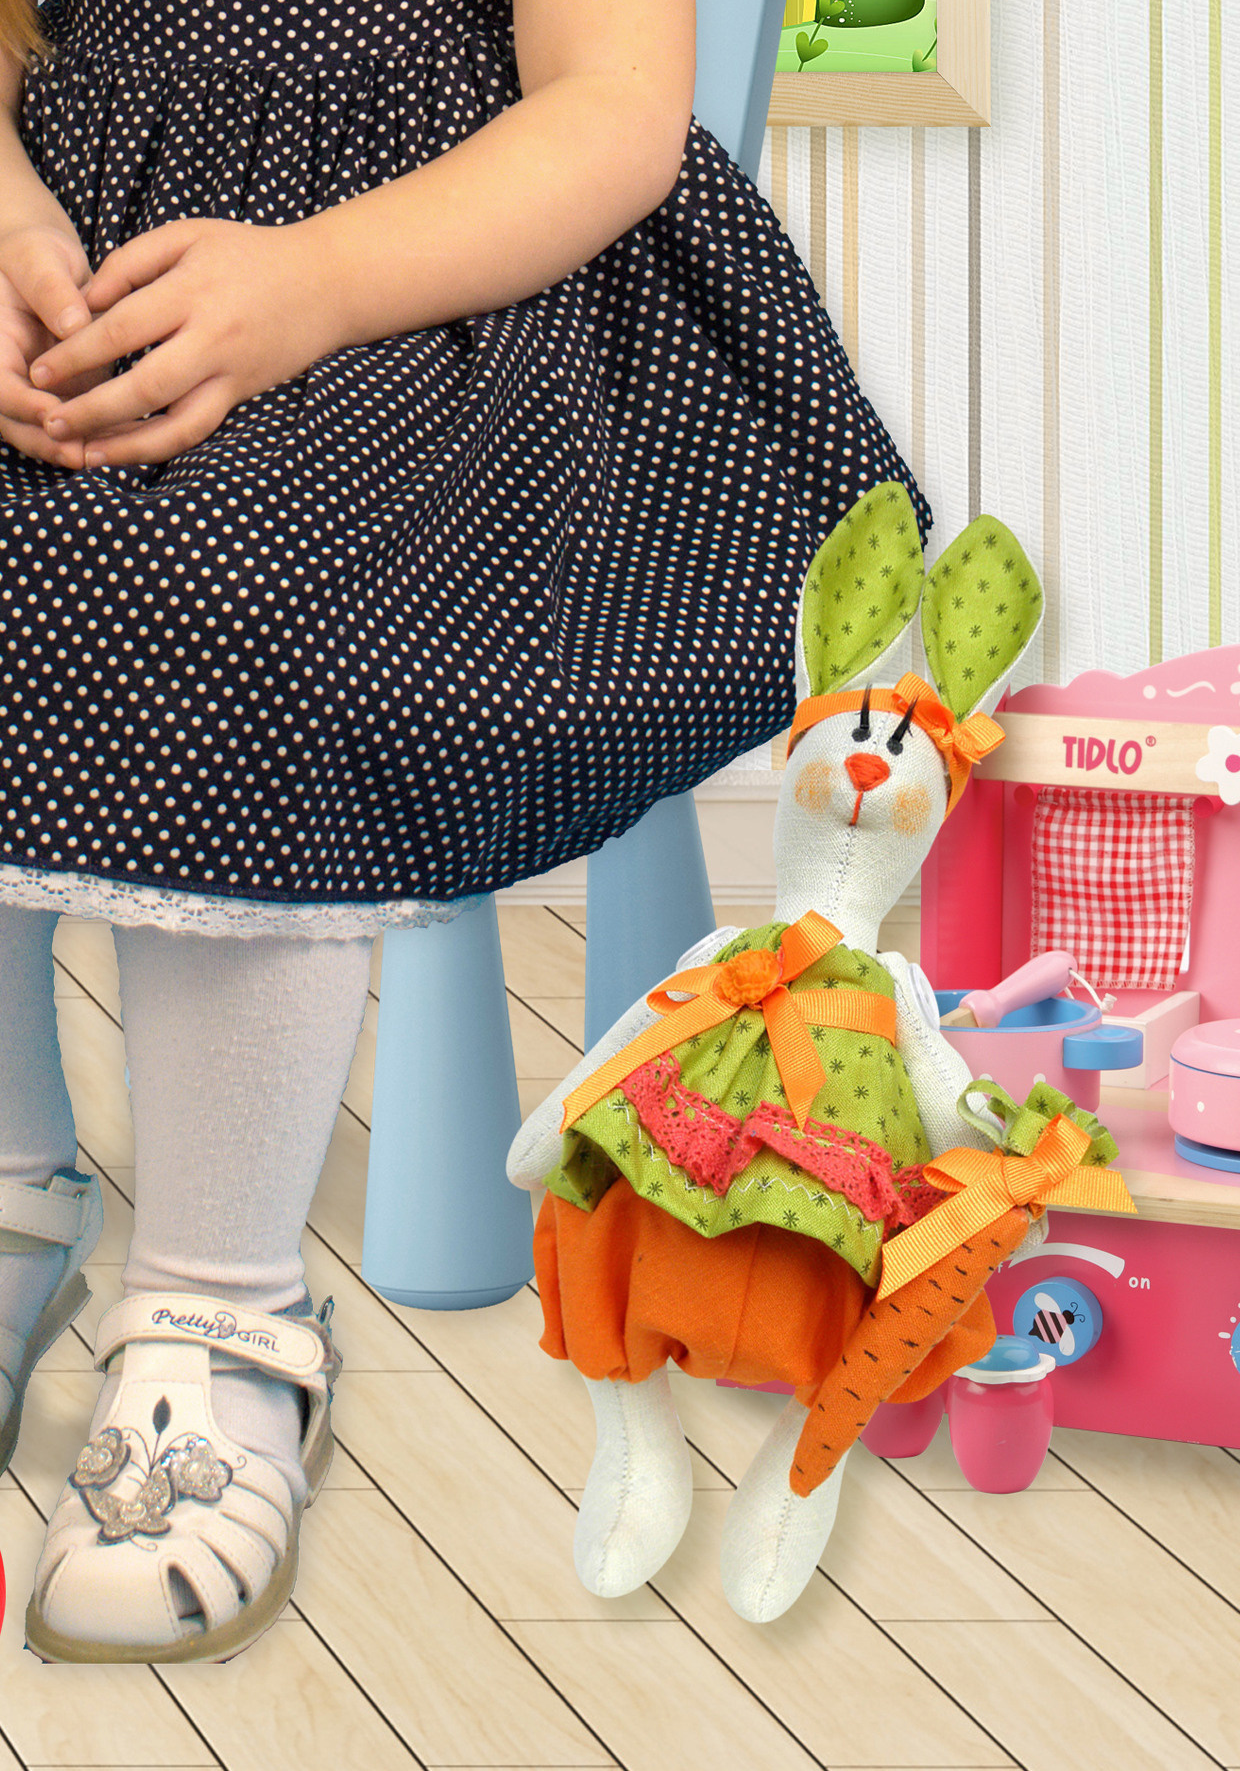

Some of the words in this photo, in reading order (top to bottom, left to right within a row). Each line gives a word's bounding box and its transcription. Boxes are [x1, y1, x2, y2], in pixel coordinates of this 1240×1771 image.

[1128, 1276, 1151, 1290] on
[151, 1308, 220, 1339] Pretty
[237, 1330, 280, 1353] GIRL
